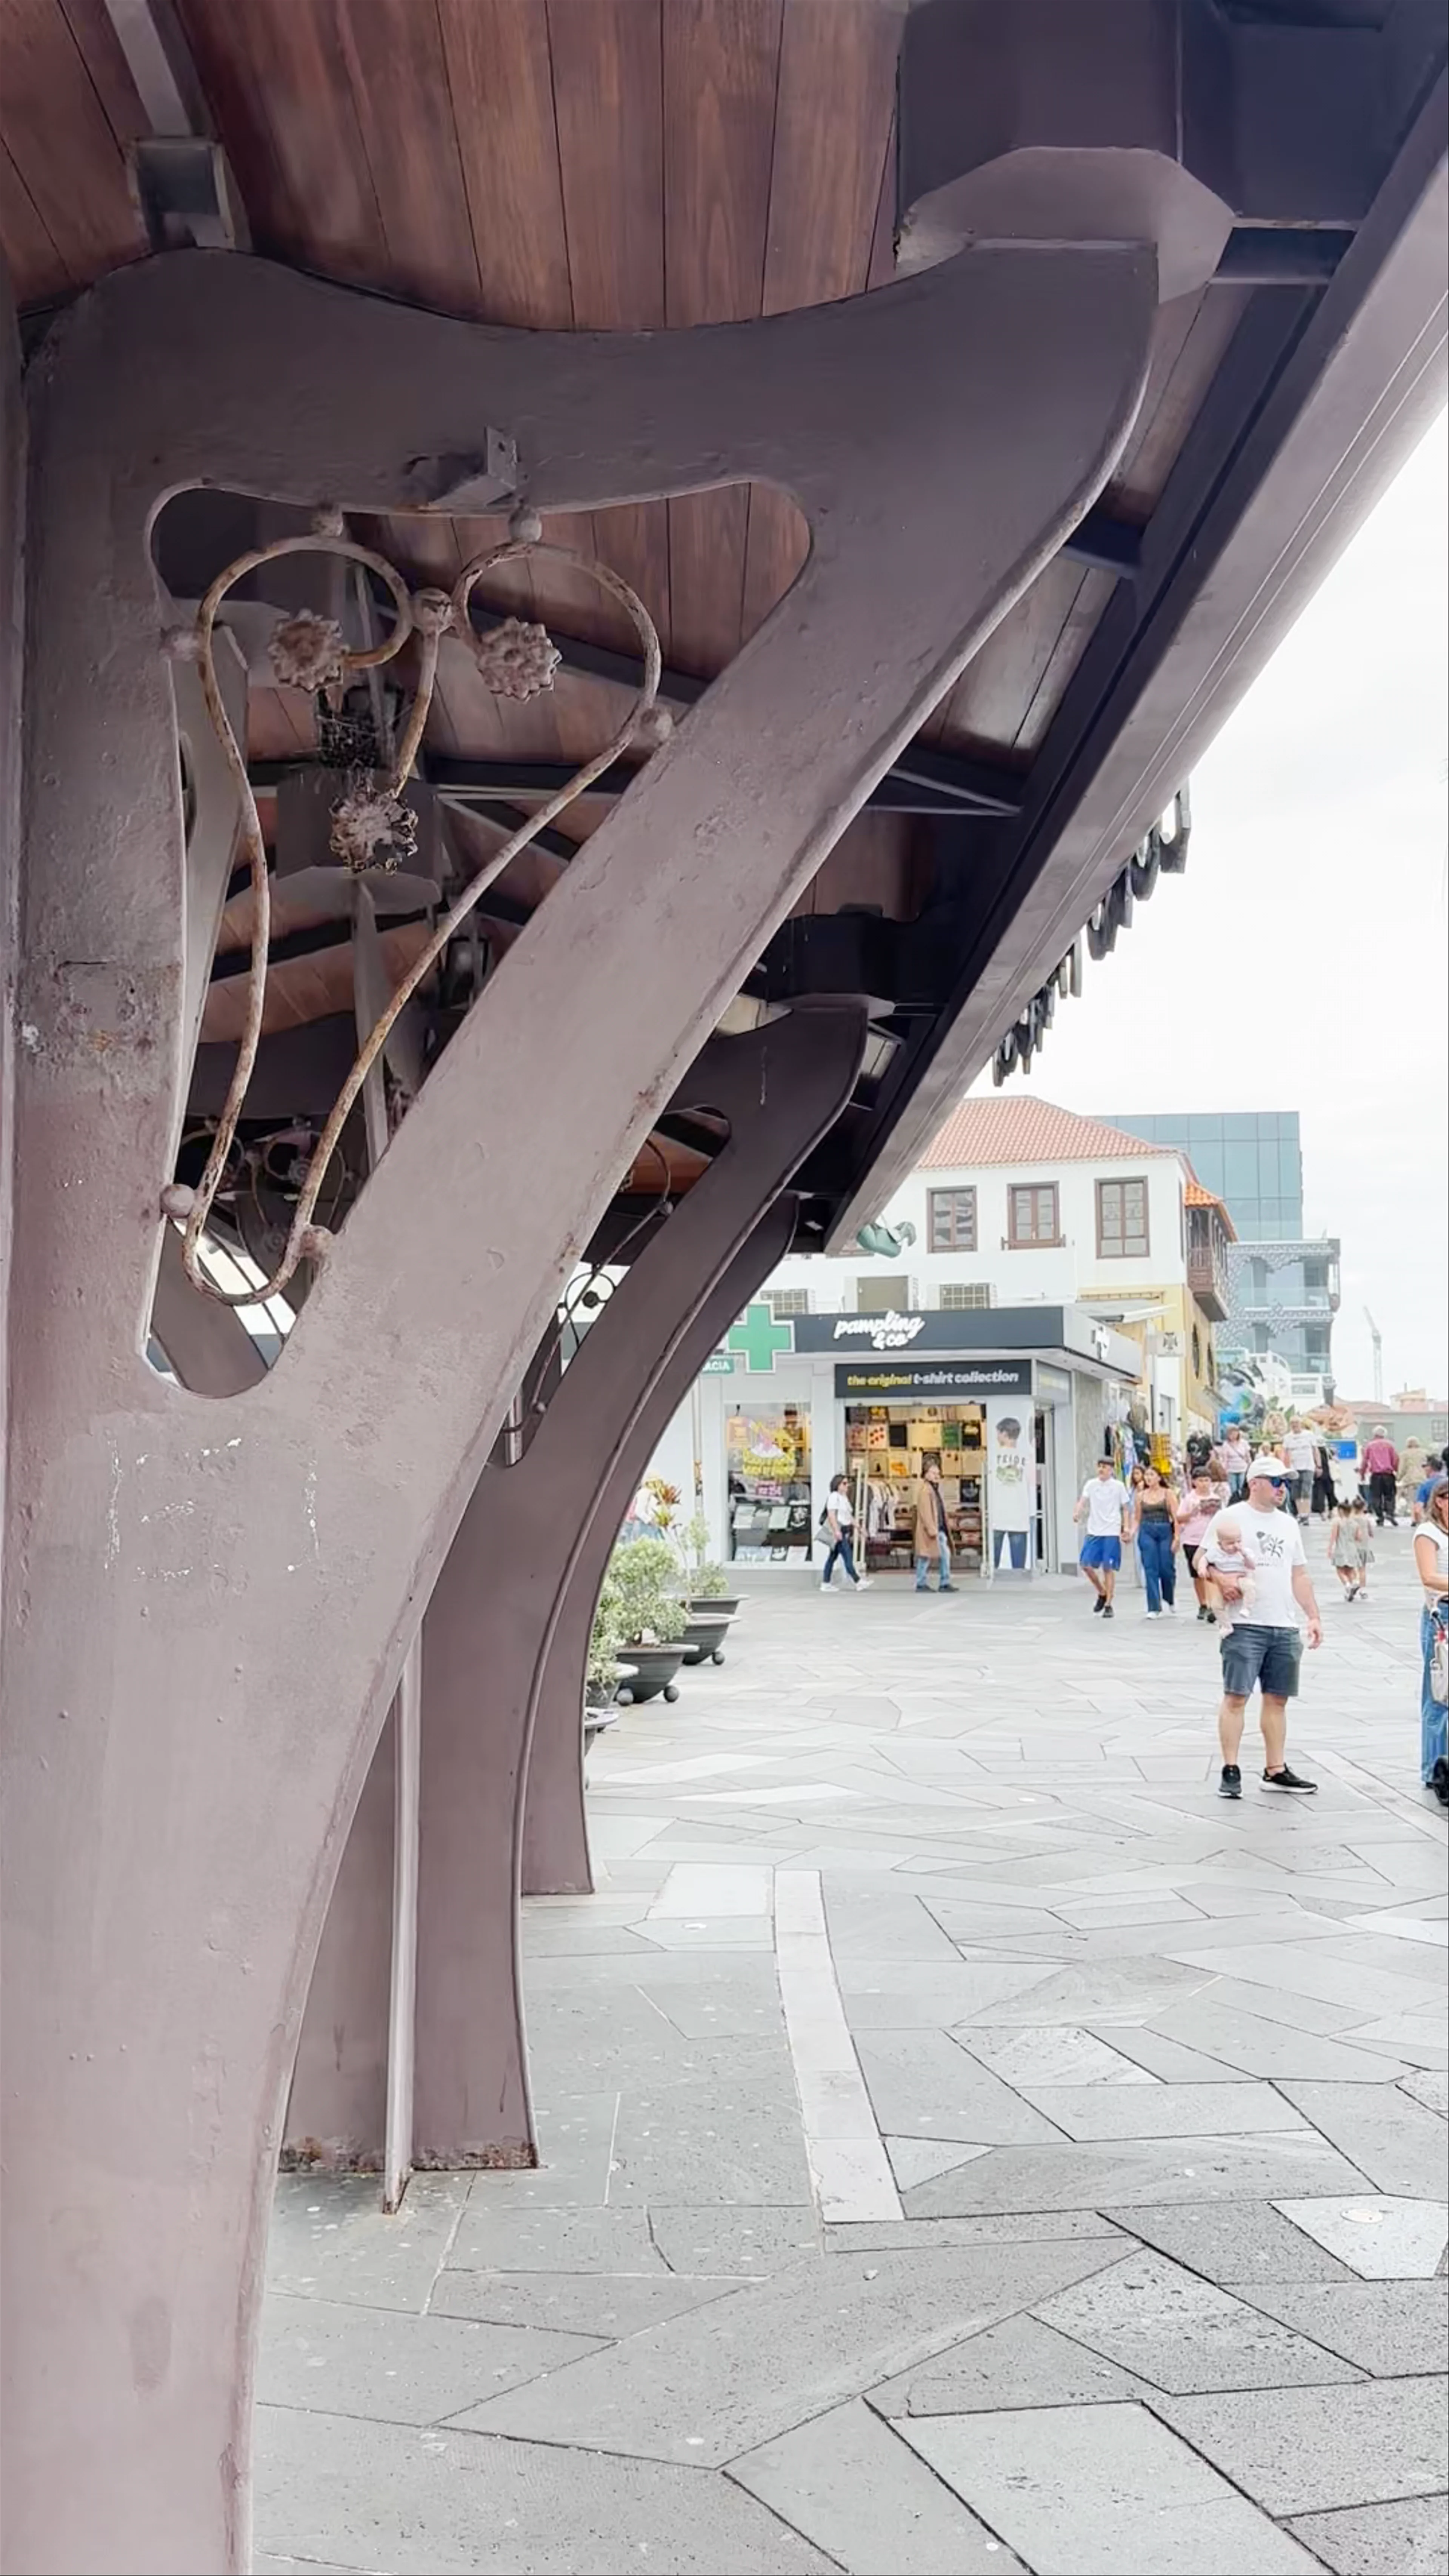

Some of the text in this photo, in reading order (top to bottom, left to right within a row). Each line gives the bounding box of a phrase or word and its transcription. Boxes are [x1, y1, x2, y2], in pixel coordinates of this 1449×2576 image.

[833, 1310, 926, 1340] pampling
[702, 1361, 730, 1371] ACIA
[848, 1369, 1019, 1387] the original t-shirt collection
